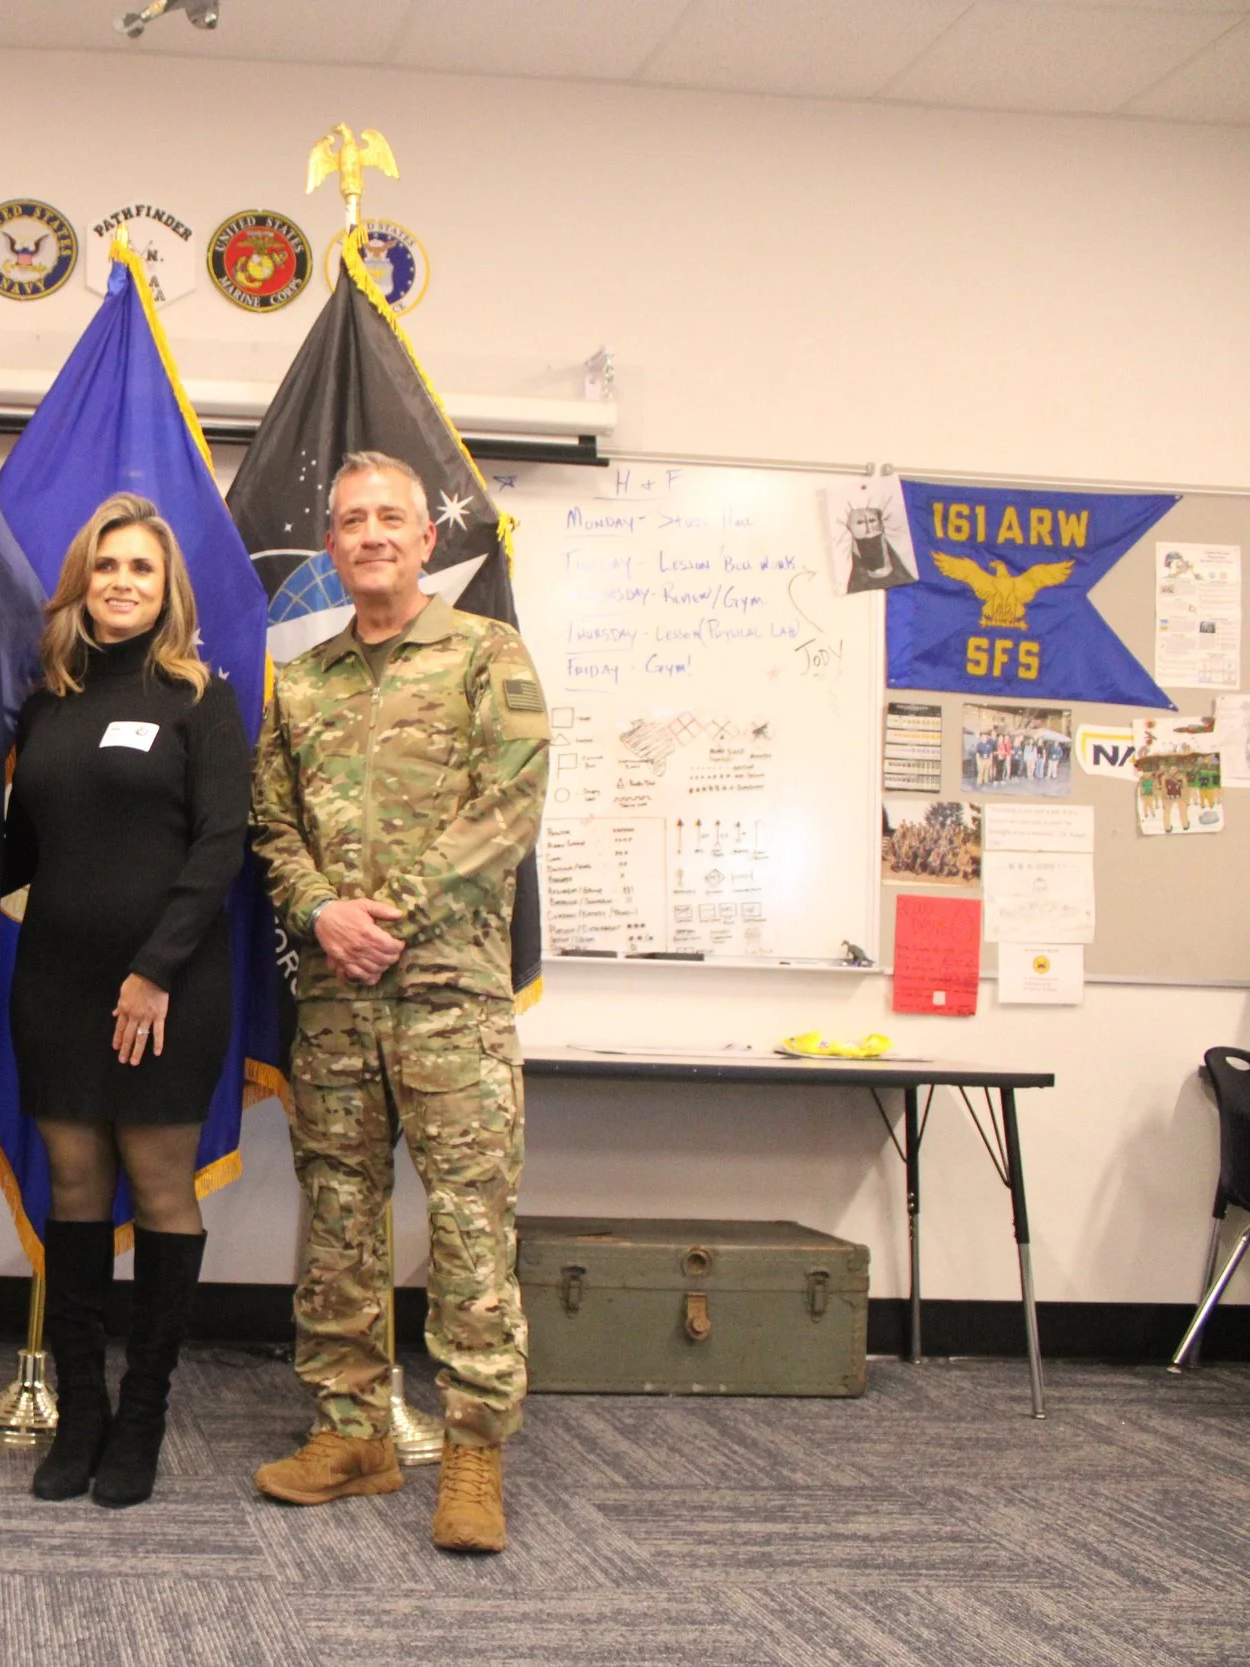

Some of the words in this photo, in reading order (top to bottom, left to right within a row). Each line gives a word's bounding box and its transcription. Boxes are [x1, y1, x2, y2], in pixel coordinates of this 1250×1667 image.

[34, 206, 72, 257] STATES
[93, 204, 192, 242] PATHFINDER
[215, 216, 256, 251] UNITED
[266, 216, 304, 253] STATES
[0, 277, 46, 296] NAVY
[220, 276, 261, 307] MARINE
[270, 279, 302, 305] CORPS
[616, 468, 631, 497] H
[932, 502, 987, 543] 161
[996, 506, 1090, 548] ARW
[966, 636, 1041, 680] SFS
